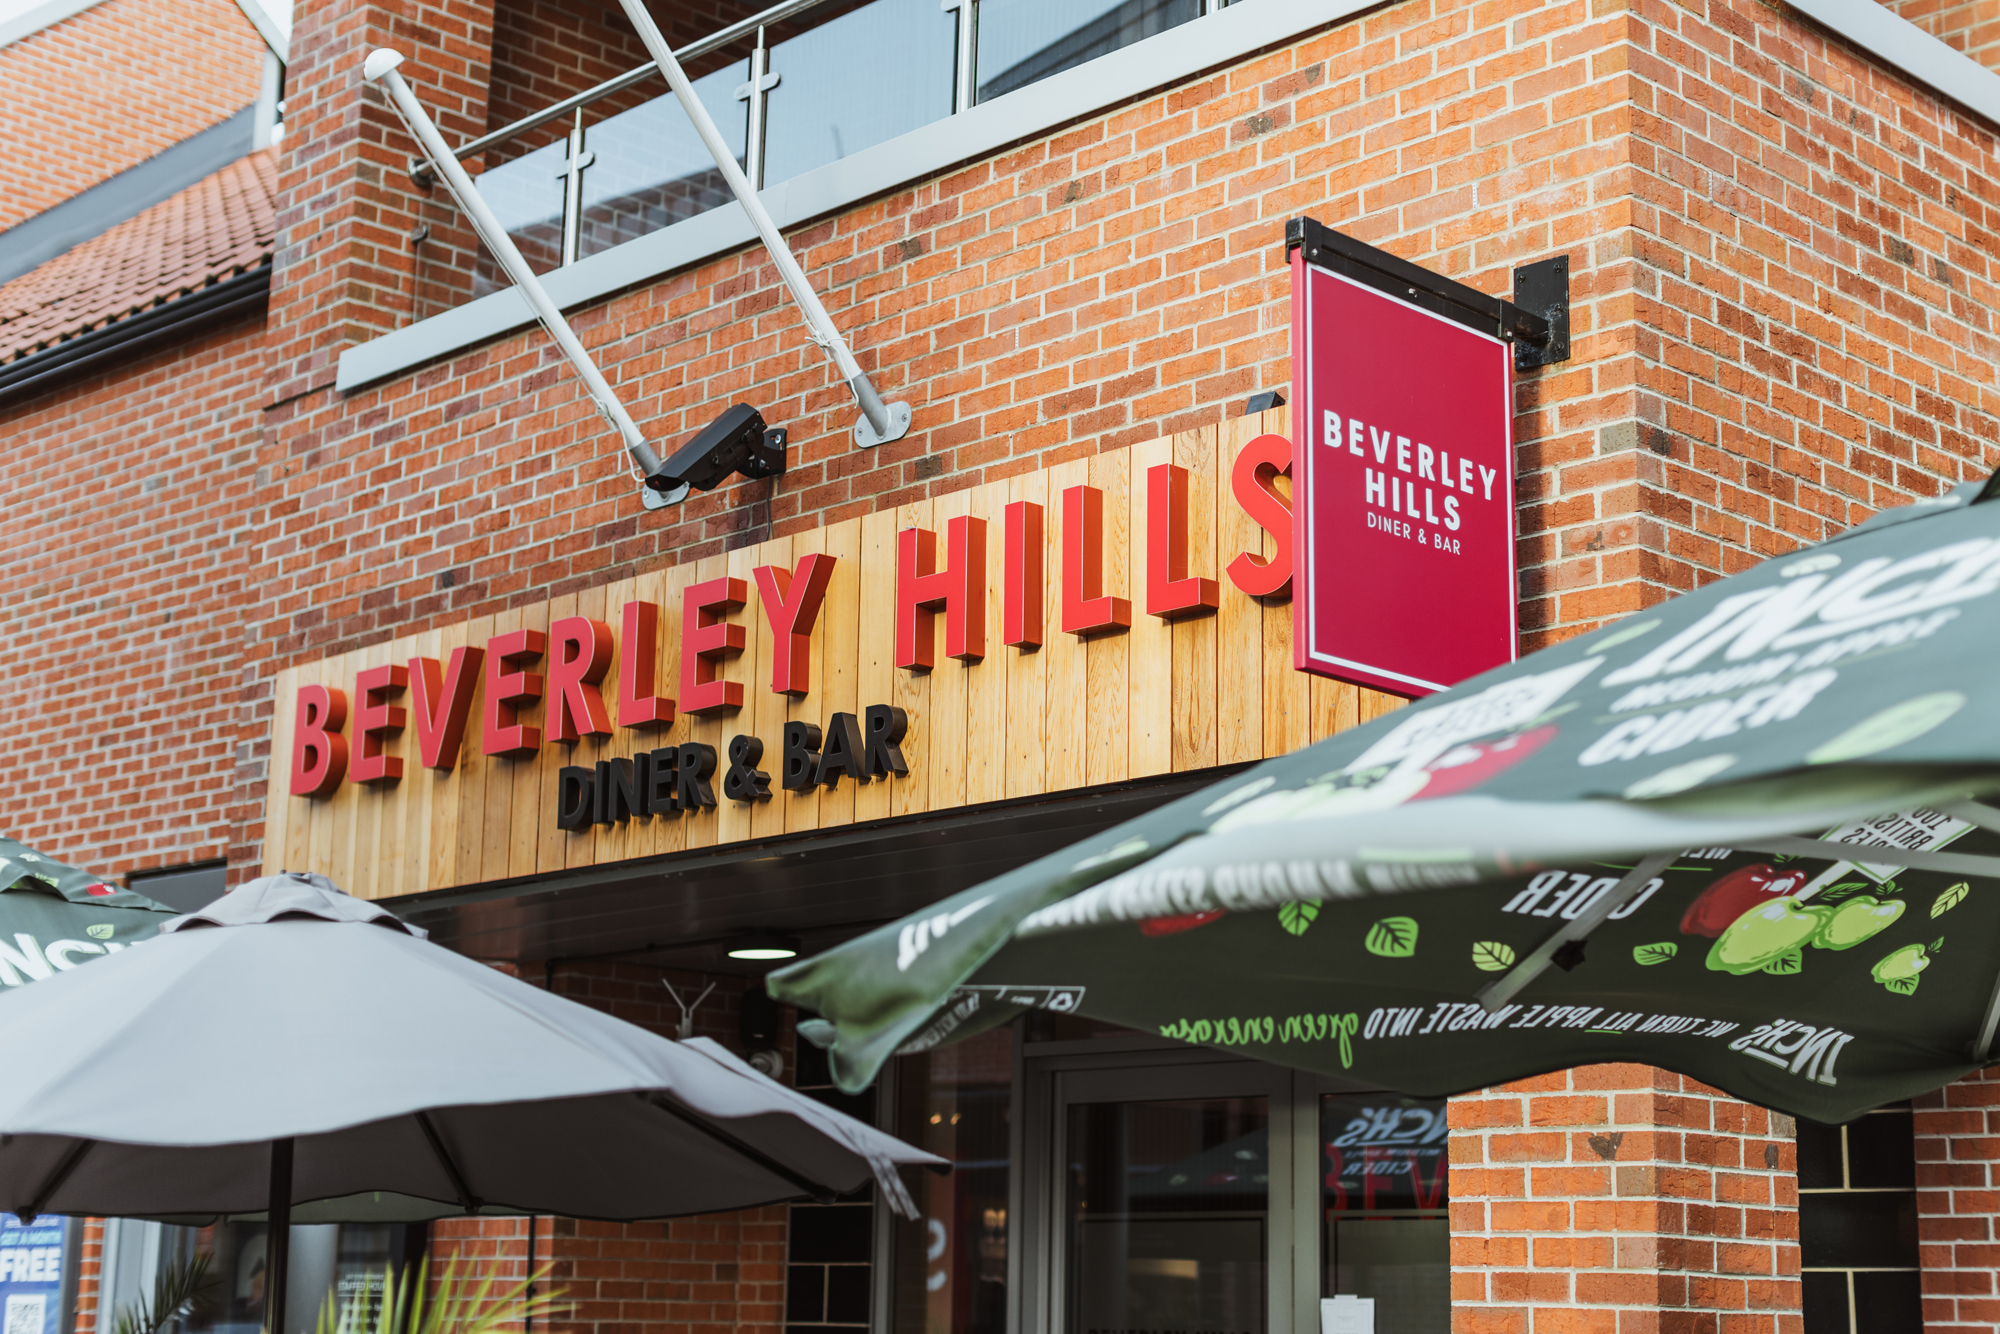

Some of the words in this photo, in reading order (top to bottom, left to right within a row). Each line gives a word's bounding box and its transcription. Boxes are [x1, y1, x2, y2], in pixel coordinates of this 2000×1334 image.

[1323, 409, 1497, 501] BEVERLEY
[1365, 467, 1461, 532] HILLS
[1367, 511, 1411, 540] DINER
[1418, 528, 1427, 545] &
[1434, 533, 1461, 555] BAR
[290, 552, 837, 799] BEVERLEY
[896, 433, 1294, 673] HILLS
[558, 743, 718, 831] DINER
[724, 735, 772, 801] &
[782, 704, 909, 792] BAR
[0, 1247, 61, 1283] FREE
